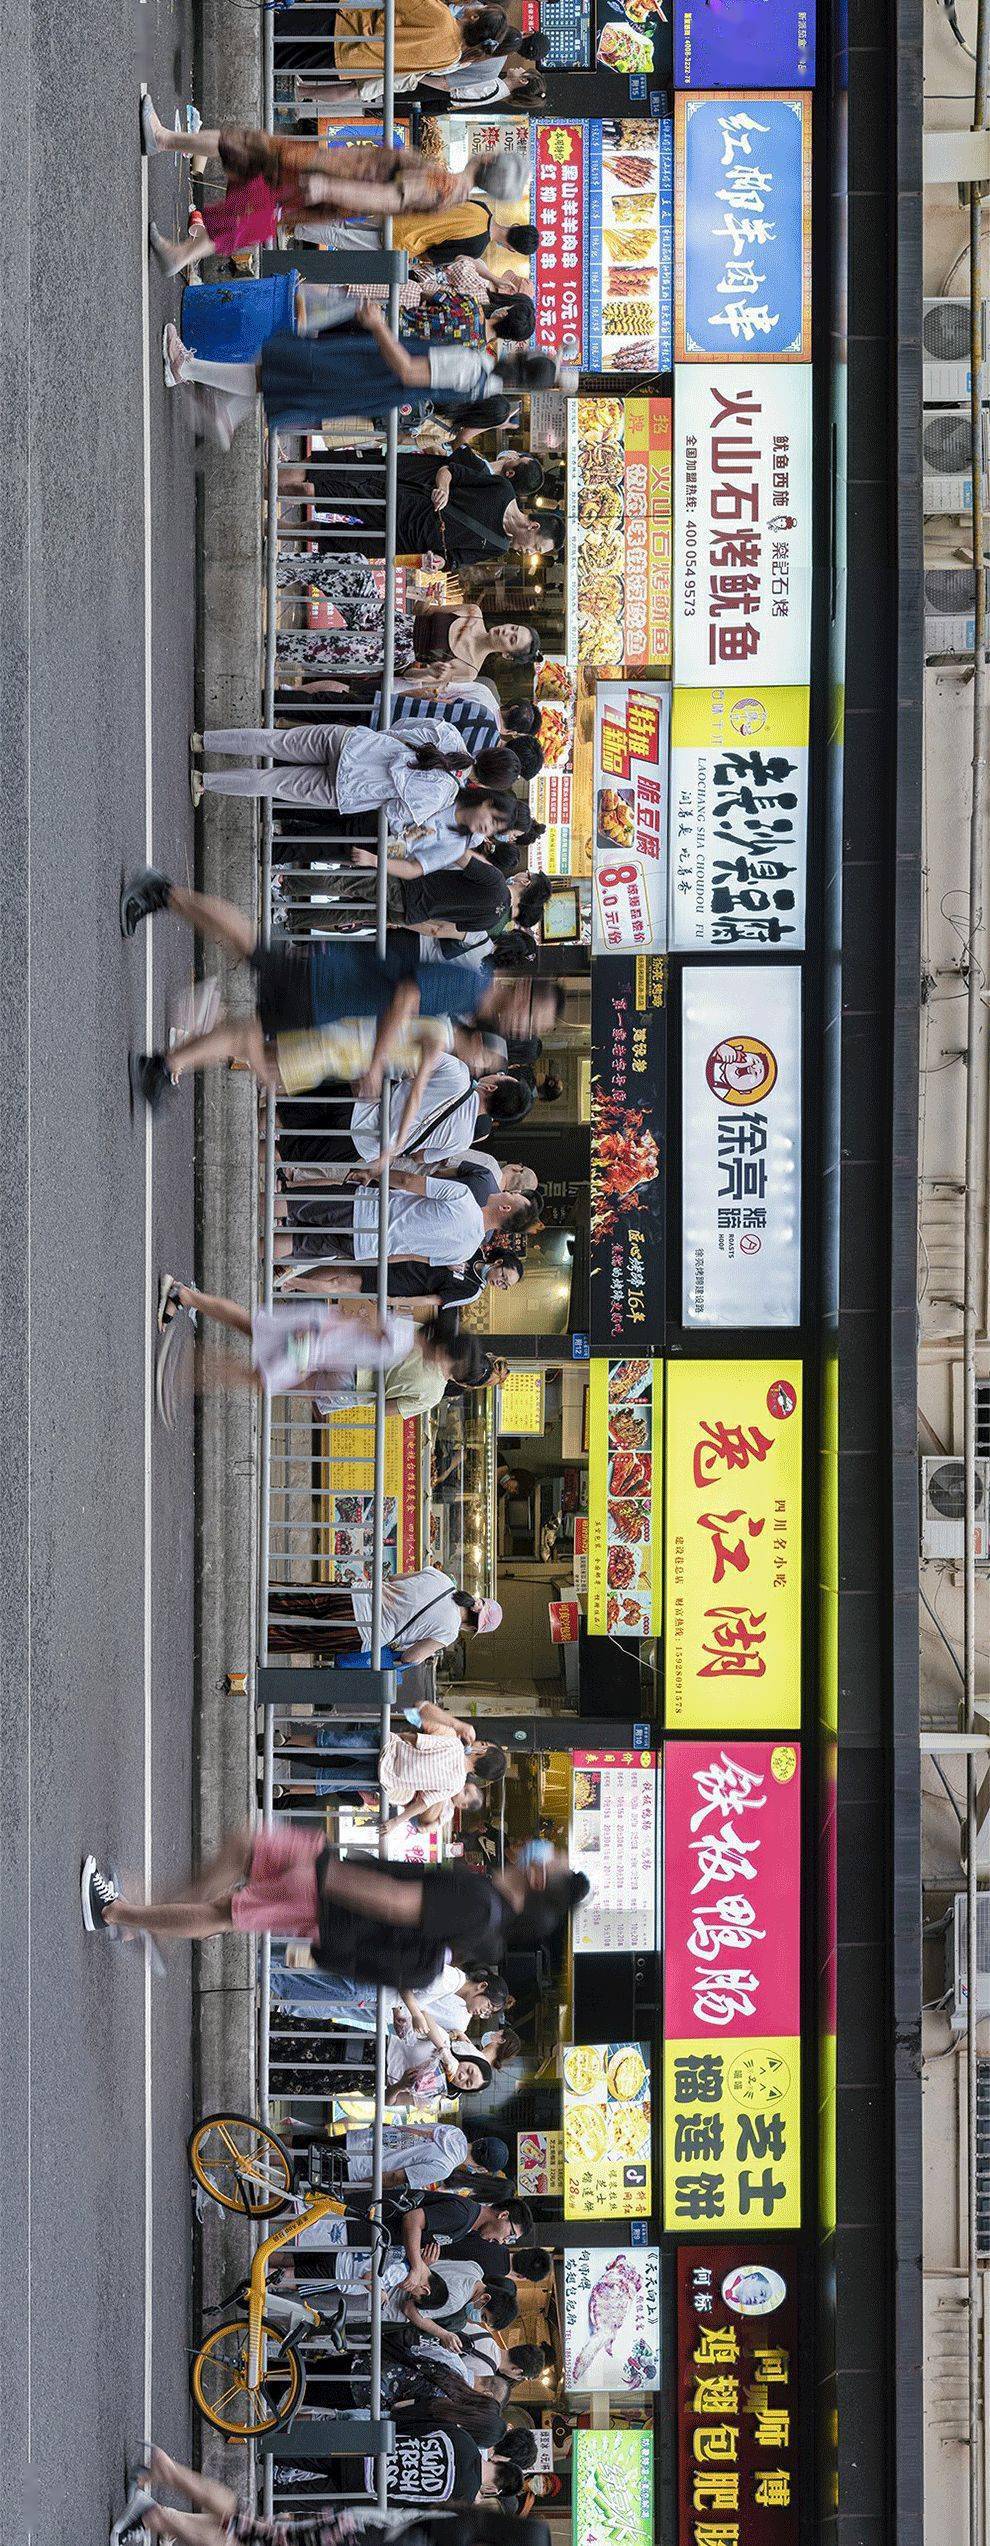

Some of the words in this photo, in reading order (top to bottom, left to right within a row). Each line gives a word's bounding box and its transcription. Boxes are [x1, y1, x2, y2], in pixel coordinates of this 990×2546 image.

[540, 164, 556, 271] 红柳羊肉串
[708, 113, 779, 341] 红柳羊肉串
[772, 435, 789, 507] 鱿鱼西施
[651, 465, 671, 655] 火山石烤鱿鱼
[685, 520, 696, 546] 400
[685, 551, 696, 577] 054
[709, 387, 762, 666] 火山石烤鱿鱼
[683, 581, 695, 618] 9573
[601, 728, 629, 772] 新品
[696, 757, 707, 822] LAOCHANG
[635, 775, 661, 860] 脆豆腐
[696, 826, 706, 855] SHA
[710, 750, 798, 945] 老長沙臭豆腐
[696, 854, 706, 914] CHOUDOU
[696, 923, 705, 940] FU
[718, 1111, 768, 1201] 徐亮
[673, 1535, 684, 1585] 建设巷总店
[692, 1420, 775, 1678] 兔江湖
[773, 1499, 787, 1587] 四川名小吃
[686, 1751, 767, 2026] 铁板鸭肠
[674, 2054, 725, 2220] 榴莲饼
[736, 2113, 787, 2217] 芝士
[692, 2266, 711, 2313] 何标
[399, 2438, 421, 2492] FRESH
[752, 2347, 790, 2508] 何师傅
